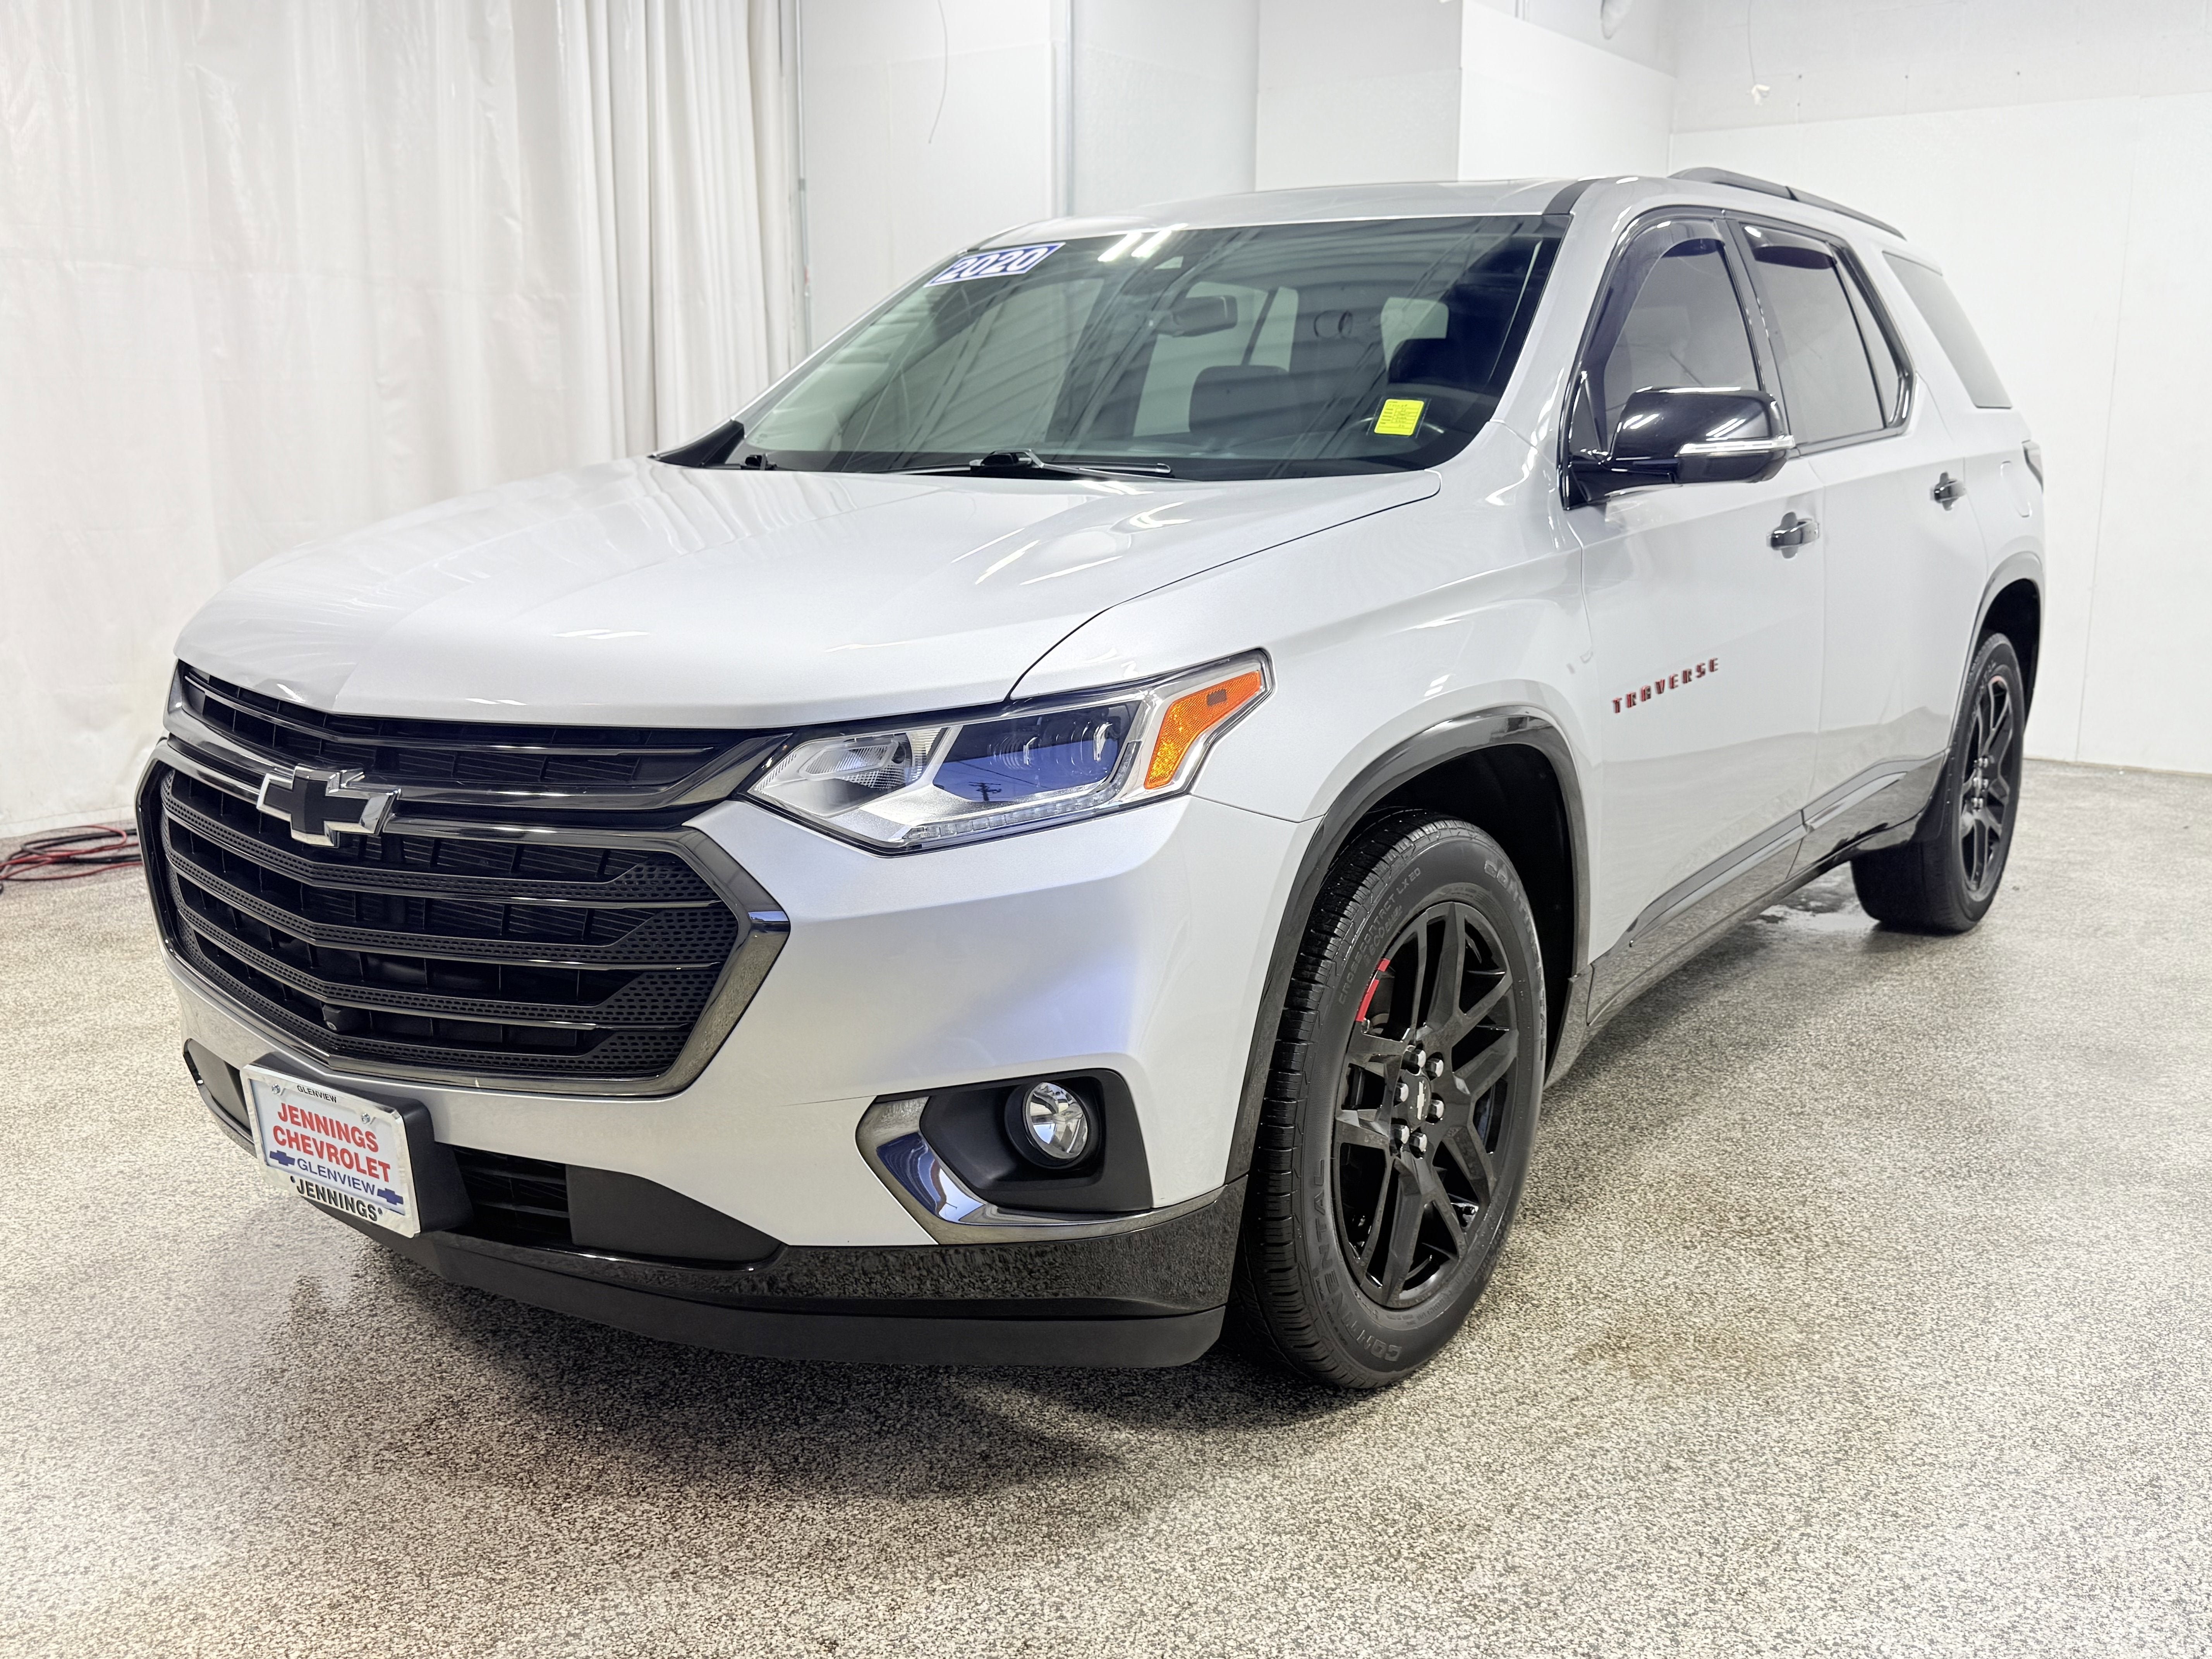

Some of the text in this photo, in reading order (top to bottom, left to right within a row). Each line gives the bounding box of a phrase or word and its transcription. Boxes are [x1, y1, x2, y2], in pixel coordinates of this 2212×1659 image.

[934, 247, 1048, 282] 2020
[1612, 658, 1719, 713] TRAVERSE
[297, 1085, 337, 1103] GLENVIEW
[278, 1103, 379, 1152] JENNINGS
[273, 1125, 391, 1183] CHEVROLET
[297, 1158, 375, 1195] GLENVIEW
[296, 1178, 378, 1221] JENNINGS
